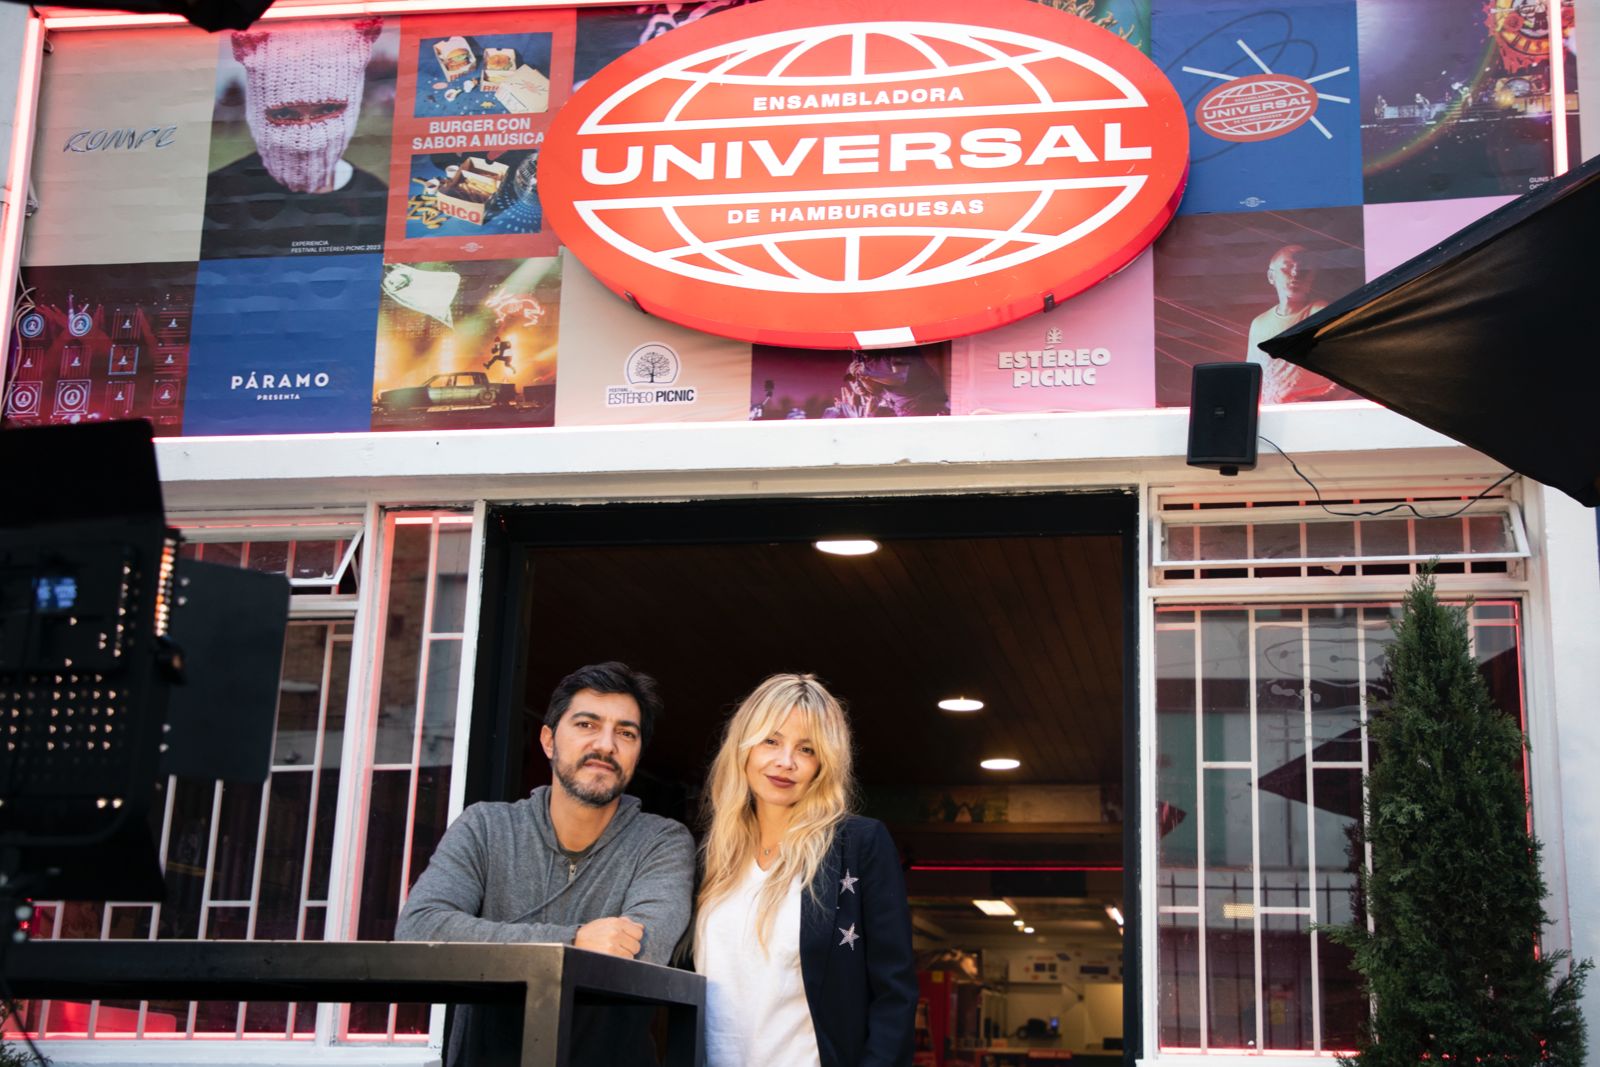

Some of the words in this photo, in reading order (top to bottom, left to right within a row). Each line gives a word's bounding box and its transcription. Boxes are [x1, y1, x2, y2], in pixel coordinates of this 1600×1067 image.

[752, 87, 965, 111] ENSAMBLADORA
[1203, 96, 1311, 119] UNIVERSAL
[429, 119, 494, 134] BURGER
[496, 117, 531, 131] CON
[412, 135, 467, 150] SABOR
[470, 134, 481, 147] A
[484, 131, 545, 147] MÚSICA
[580, 122, 1153, 186] UNIVERSAL
[440, 201, 481, 224] RICO
[727, 209, 761, 224] DE
[770, 199, 985, 222] HAMBURGUESAS
[998, 345, 1111, 369] ESTÉREO
[231, 371, 330, 390] PÁRAMO
[1013, 368, 1097, 388] PICNIC
[656, 389, 695, 403] PICNIC
